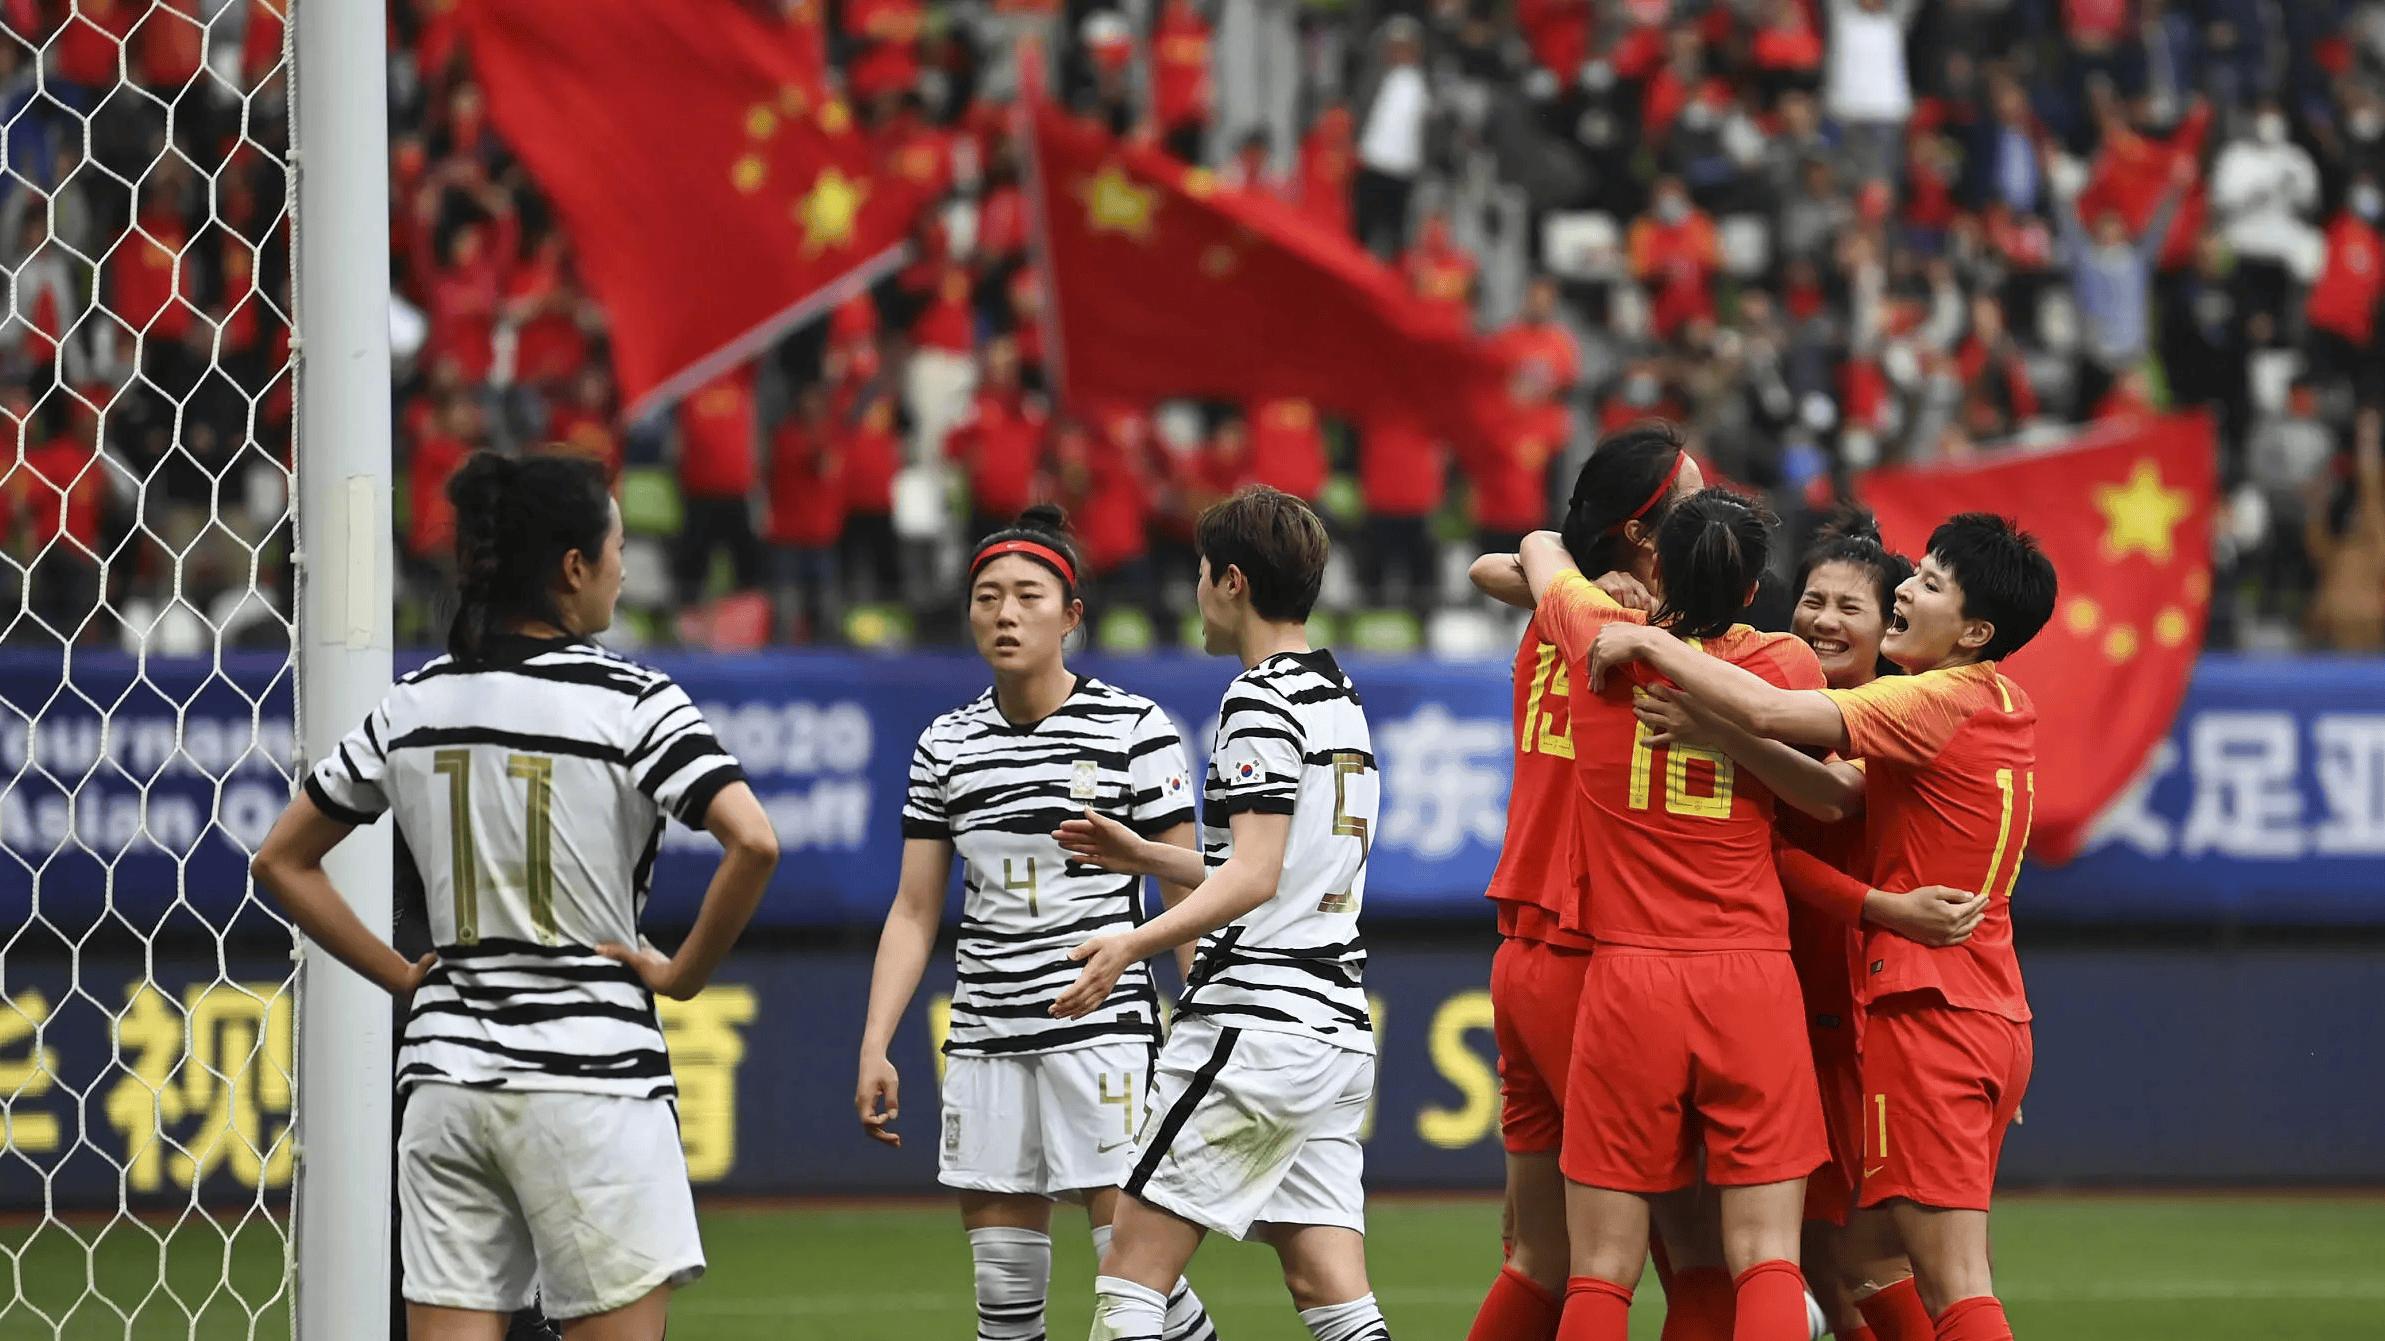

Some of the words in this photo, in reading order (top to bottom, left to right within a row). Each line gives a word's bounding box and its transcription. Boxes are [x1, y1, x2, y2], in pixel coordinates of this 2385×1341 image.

[434, 749, 559, 946] 11
[1003, 857, 1038, 917] 4
[1317, 753, 1369, 913] 5
[1099, 1072, 1132, 1135] 4
